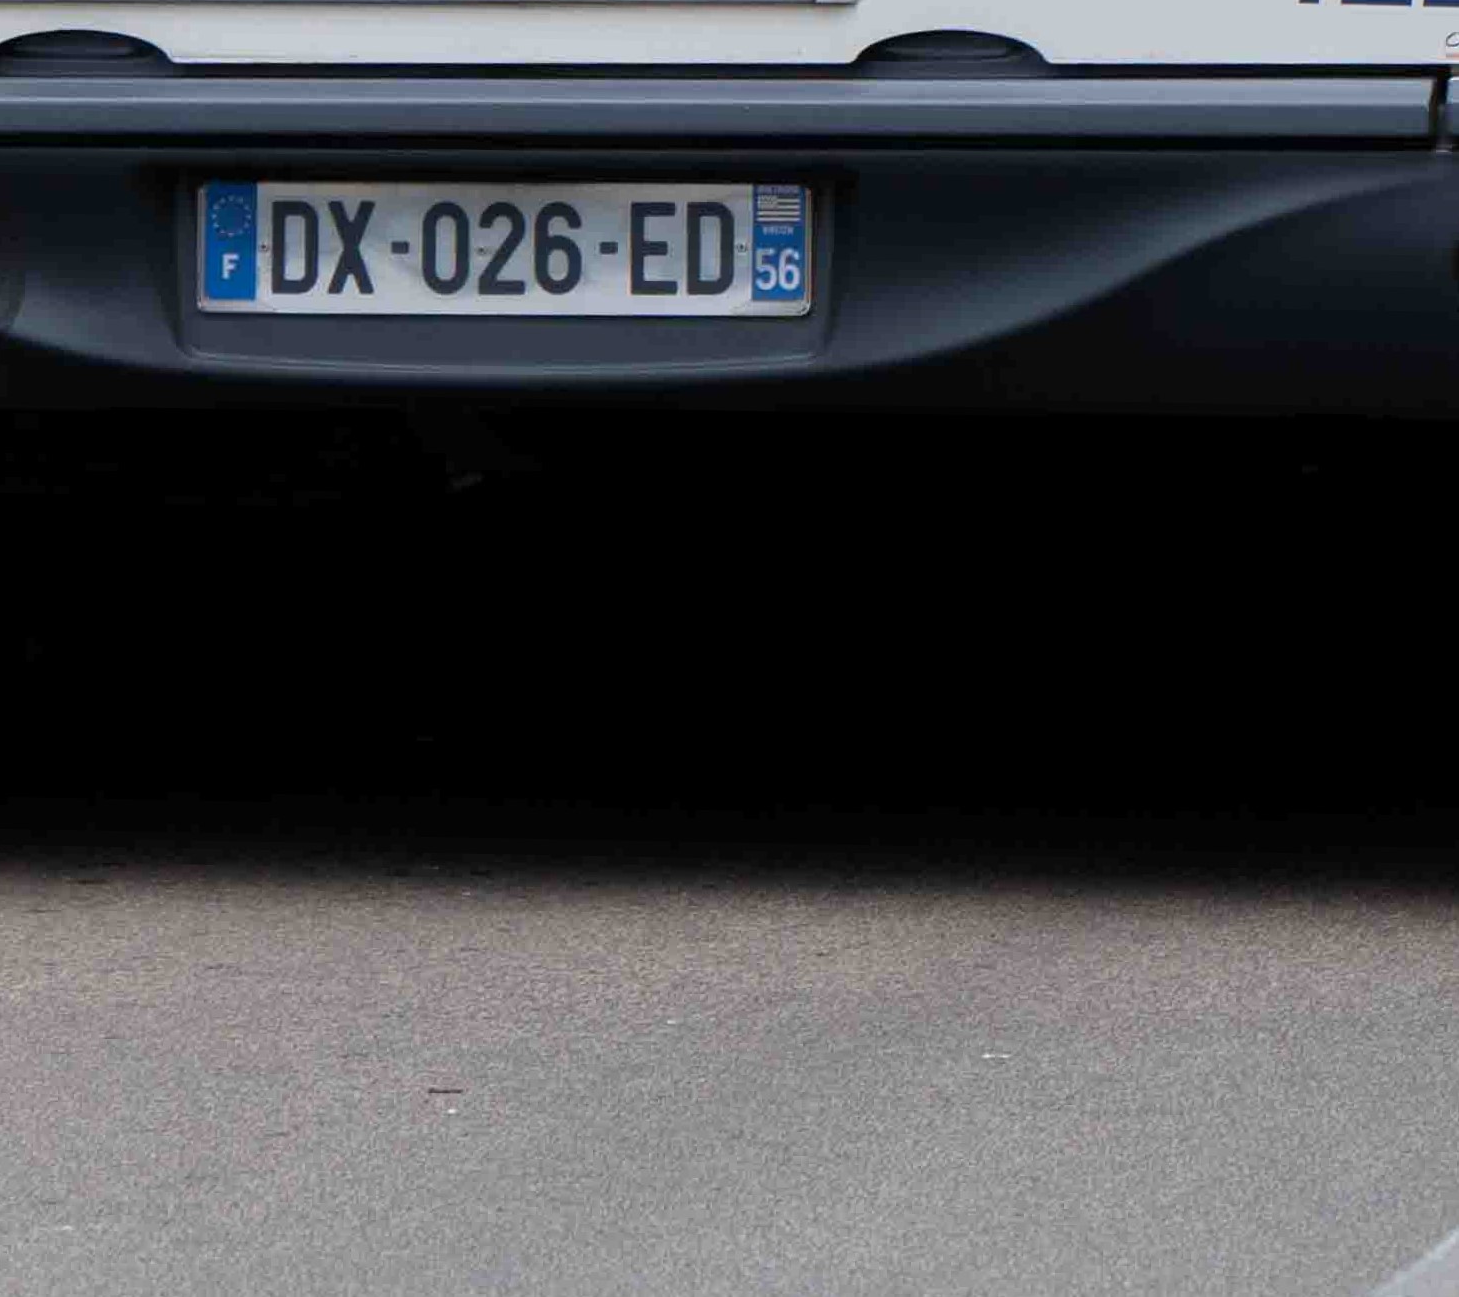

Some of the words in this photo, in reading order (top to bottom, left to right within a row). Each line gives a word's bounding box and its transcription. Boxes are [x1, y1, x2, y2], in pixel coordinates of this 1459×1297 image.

[221, 253, 240, 280] F
[271, 197, 736, 296] DX-026-ED
[755, 246, 801, 291] 56
